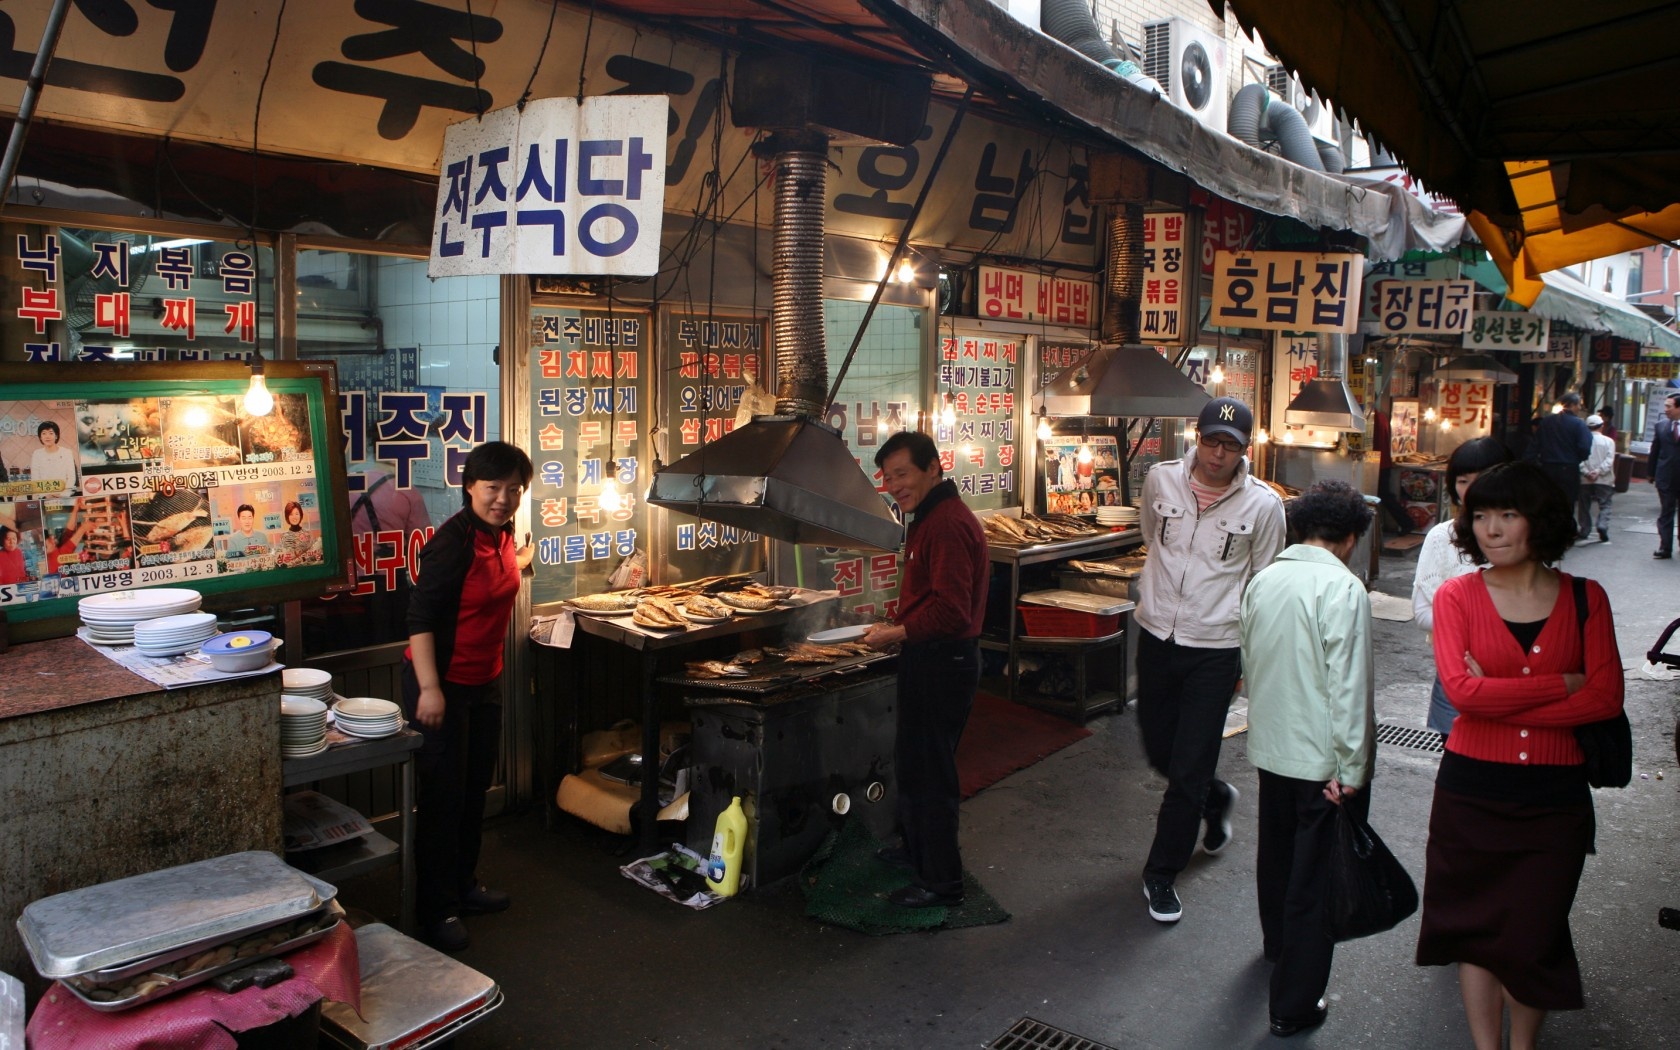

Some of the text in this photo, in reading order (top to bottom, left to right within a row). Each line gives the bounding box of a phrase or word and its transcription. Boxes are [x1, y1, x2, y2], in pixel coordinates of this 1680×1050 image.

[440, 137, 653, 258] 전주식당
[18, 234, 255, 294] 낙지볶음
[985, 271, 1090, 326] 냉면 비빔밥
[1219, 257, 1350, 327] 호남집
[18, 287, 255, 343] 부대찌개
[542, 316, 639, 346] 전주비빔밥
[678, 320, 761, 349] 부대찌게
[1468, 316, 1545, 346] 생선본가
[538, 350, 638, 378] 김치찌게
[679, 352, 761, 379] 제육볶음
[942, 338, 1017, 363] 김치찌게
[941, 366, 1015, 389] 뚝배기불고기
[538, 386, 637, 417] 된장찌게
[679, 386, 748, 413] 오징어백
[1440, 383, 1488, 405] 생선
[1219, 404, 1235, 421] NY
[1440, 407, 1488, 429] 본가
[538, 420, 638, 450] 순두부
[938, 420, 1014, 444] 버섯찌게
[102, 464, 313, 498] KBS 세상의아침 TV방영 2003. 12. 2
[540, 456, 638, 489] 육계장
[540, 493, 636, 527] 청국장
[538, 528, 637, 566] 해물잡탕
[82, 571, 133, 591] TV방영
[141, 568, 178, 582] 2003.
[183, 564, 202, 577] 12.
[206, 563, 214, 574] 3
[831, 554, 898, 597] 전문
